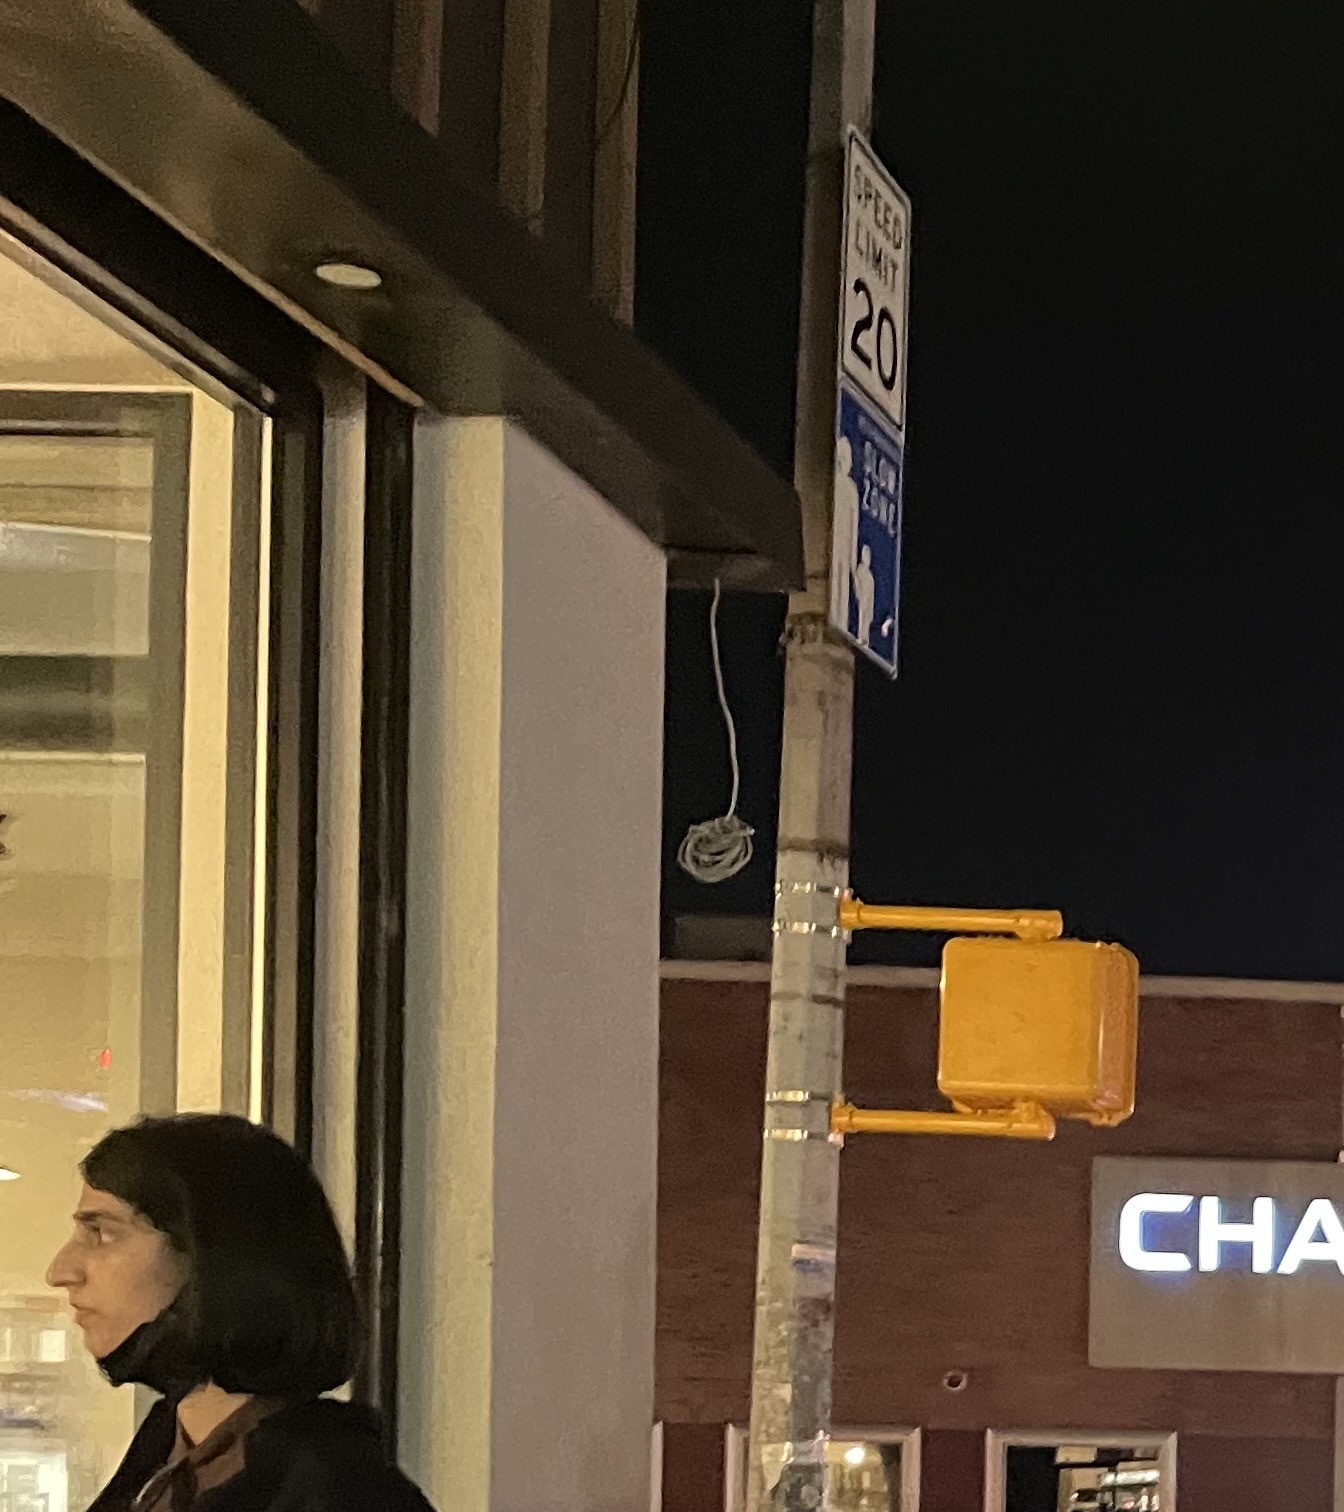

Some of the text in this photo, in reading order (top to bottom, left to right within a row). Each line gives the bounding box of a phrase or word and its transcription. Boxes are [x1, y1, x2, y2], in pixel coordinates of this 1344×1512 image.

[855, 164, 903, 250] SPEED
[855, 217, 898, 293] LIMIT
[851, 277, 898, 392] 20
